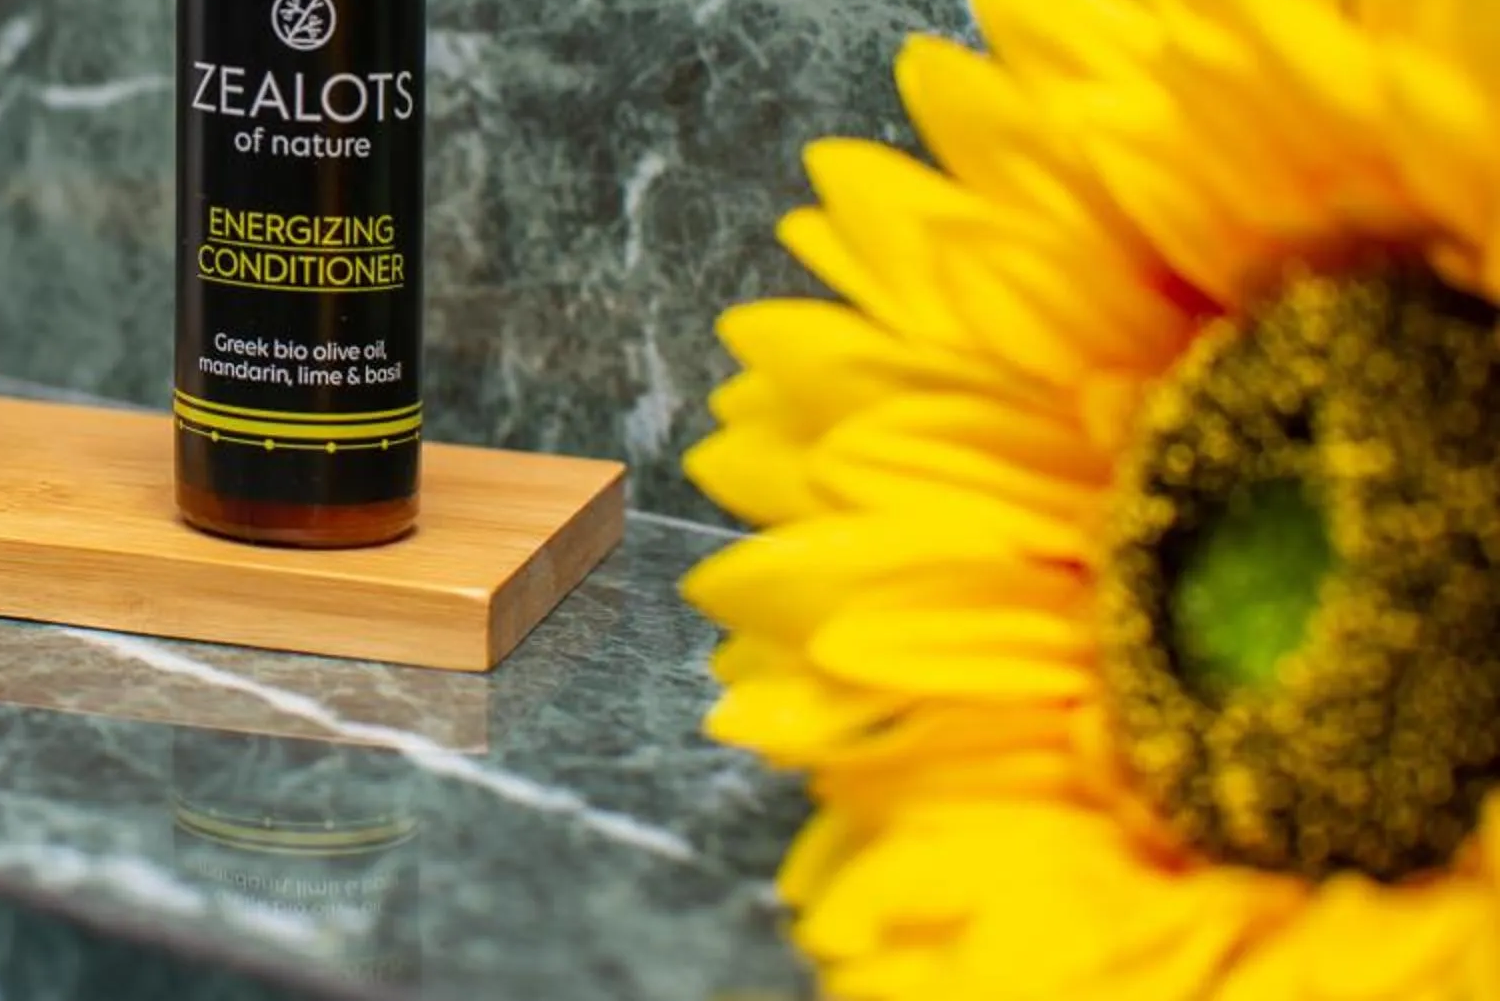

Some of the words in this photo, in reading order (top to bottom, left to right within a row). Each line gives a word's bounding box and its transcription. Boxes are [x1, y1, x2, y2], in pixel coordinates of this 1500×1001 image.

[191, 60, 413, 123] ZEALOTS
[234, 127, 265, 153] of
[272, 134, 371, 158] nature
[209, 206, 394, 246] ENERGIZING
[198, 245, 404, 286] CONDITIONER
[214, 332, 269, 357] Greek
[273, 337, 309, 360] bio
[313, 341, 361, 362] olive
[364, 340, 387, 360] oil,
[199, 356, 293, 387] mandarin,
[298, 365, 343, 386] lime
[347, 367, 361, 386] &
